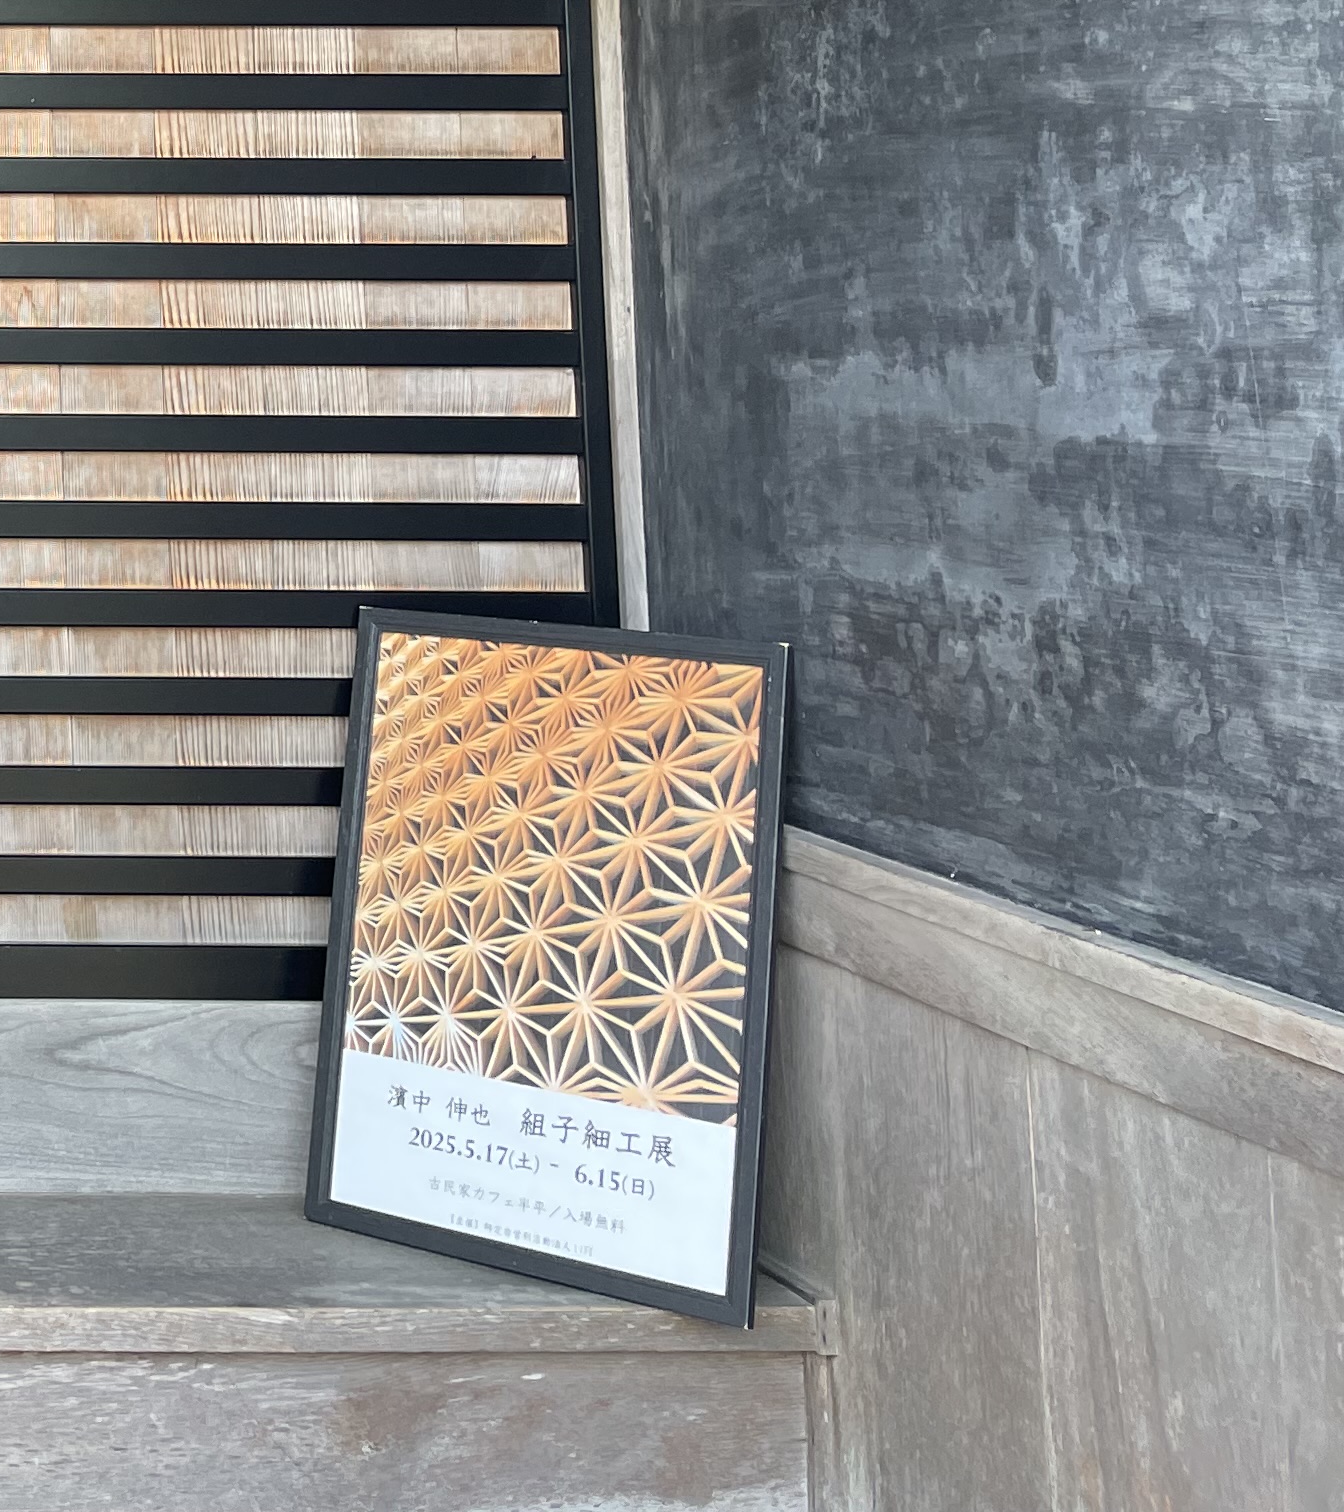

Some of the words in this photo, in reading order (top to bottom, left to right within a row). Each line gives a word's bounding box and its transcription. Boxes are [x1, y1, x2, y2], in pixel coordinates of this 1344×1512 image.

[387, 1084, 431, 1114] 濱中
[445, 1096, 490, 1127] 伸也
[519, 1107, 676, 1168] 組子細工展
[408, 1126, 540, 1175] 2025.5.17(土)
[574, 1163, 655, 1201] 6.15(日)
